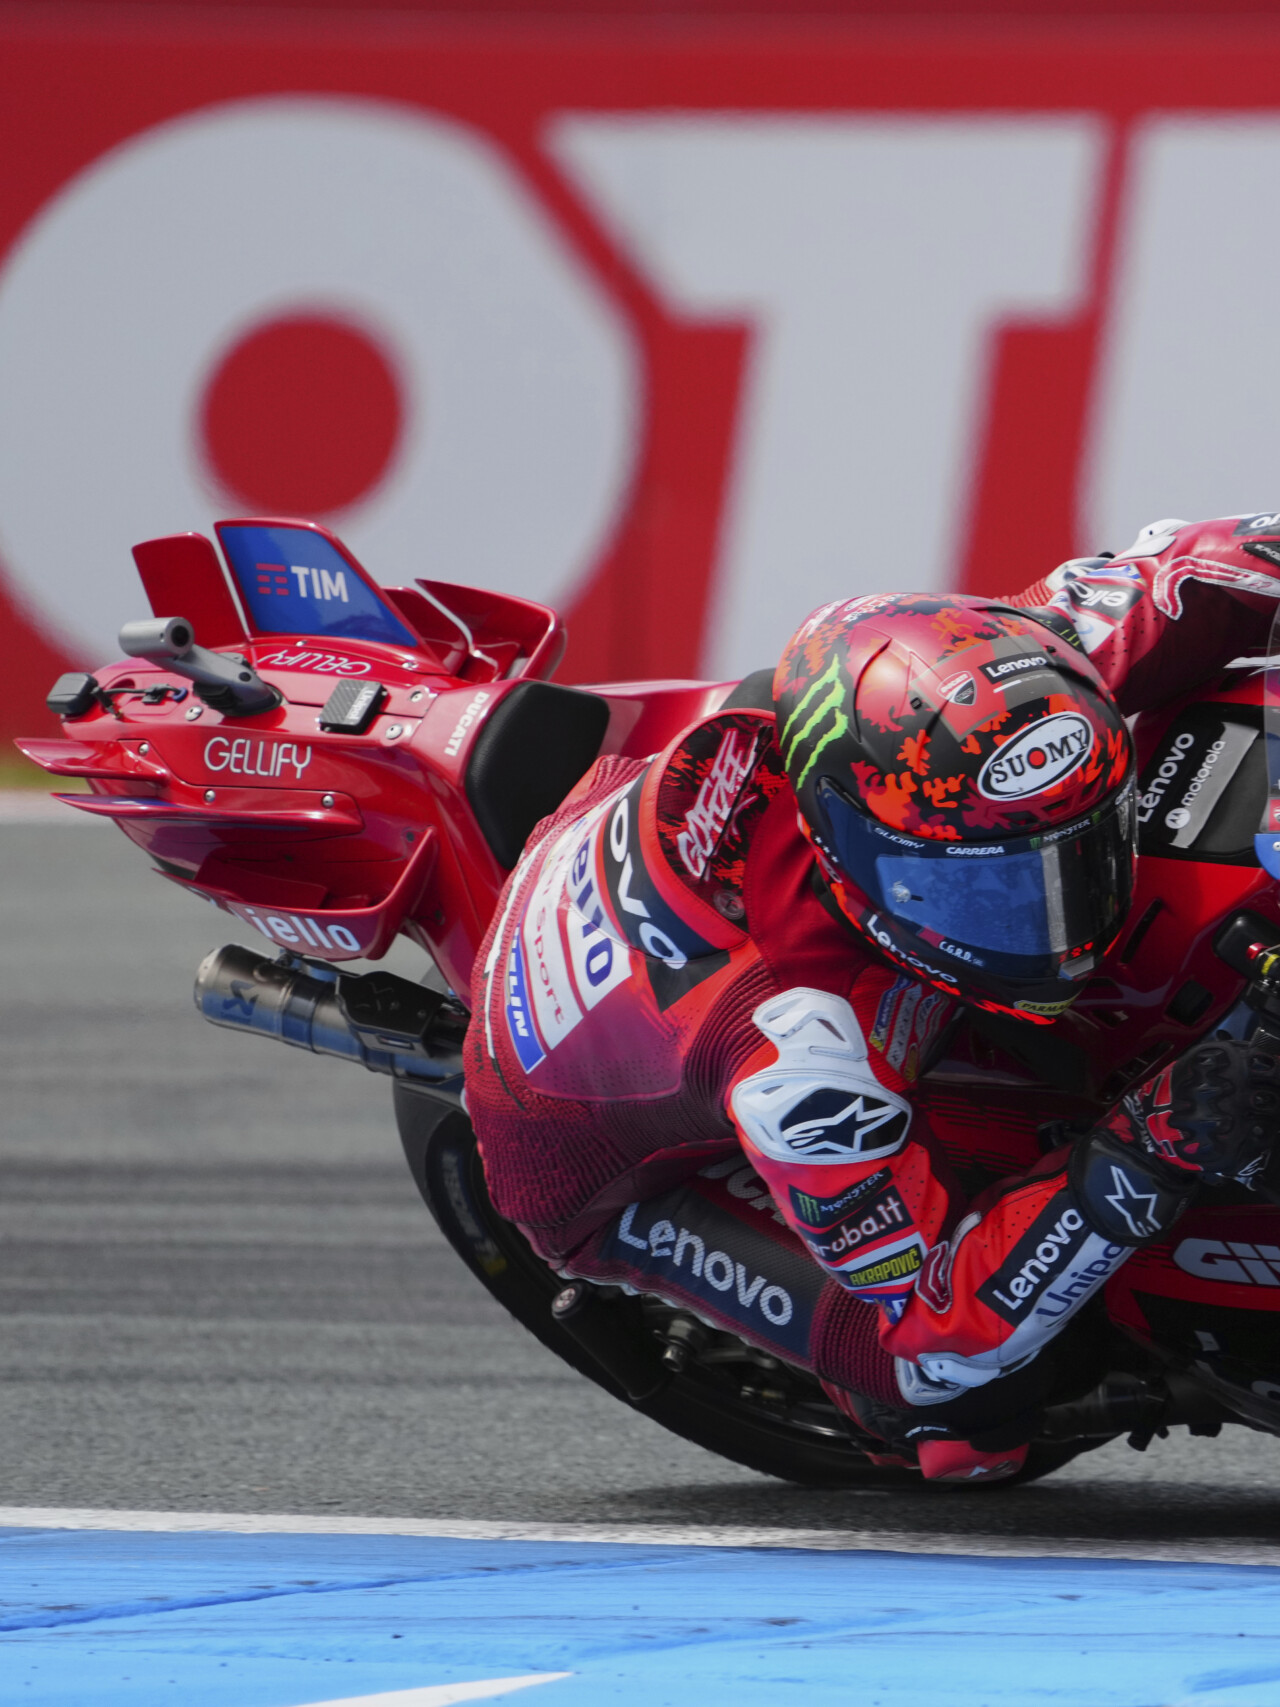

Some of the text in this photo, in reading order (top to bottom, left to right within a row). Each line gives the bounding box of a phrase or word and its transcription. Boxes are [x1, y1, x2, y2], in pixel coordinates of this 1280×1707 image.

[291, 566, 350, 603] TIM
[257, 648, 372, 676] GELLIFY
[985, 656, 1048, 678] Lenovo
[443, 690, 490, 758] DUCATI
[989, 728, 1088, 784] SUOMY
[203, 736, 312, 779] GELLIFY
[1136, 732, 1195, 823] Lenovo
[1180, 740, 1227, 807] motorola
[609, 797, 689, 970] ovo
[945, 846, 1005, 856] CARRERA
[243, 906, 361, 952] iello
[571, 838, 614, 988] ello
[866, 913, 959, 984] Lenovo
[819, 1170, 884, 1213] MONSTER
[805, 1195, 904, 1258] aruba.it
[617, 1200, 794, 1327] Lenovo
[991, 1208, 1085, 1311] Lenovo
[1035, 1242, 1126, 1318] Unipo
